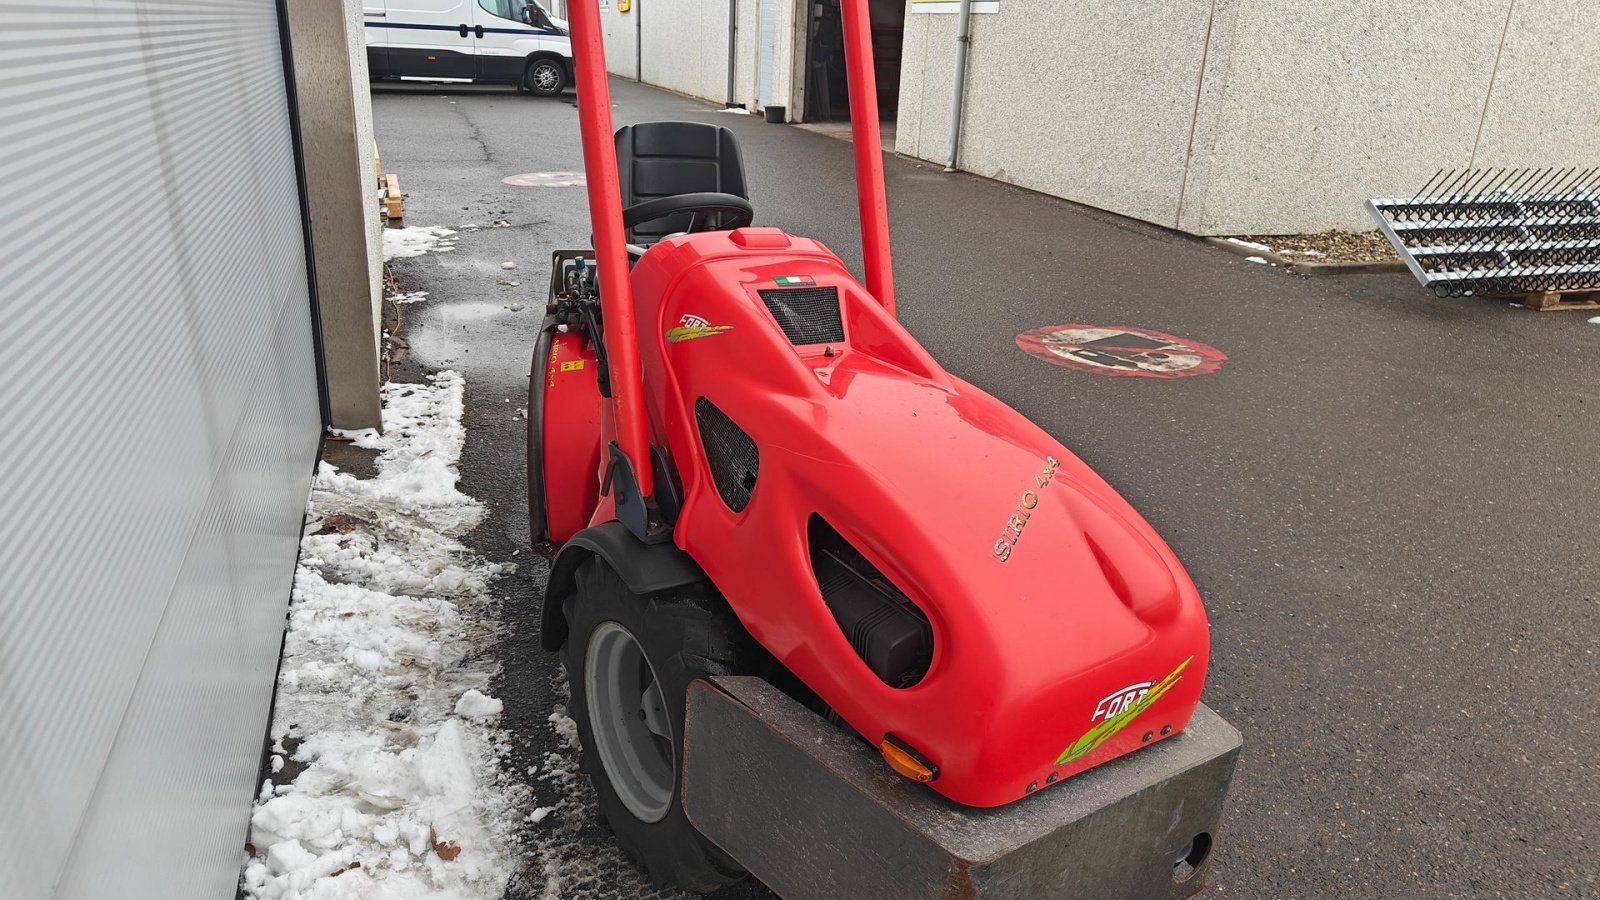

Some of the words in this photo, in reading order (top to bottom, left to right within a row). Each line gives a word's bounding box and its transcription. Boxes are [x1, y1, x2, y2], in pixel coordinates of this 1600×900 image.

[993, 489, 1039, 563] SIRIO
[1035, 455, 1060, 488] 4x4
[1090, 681, 1152, 722] FORT
